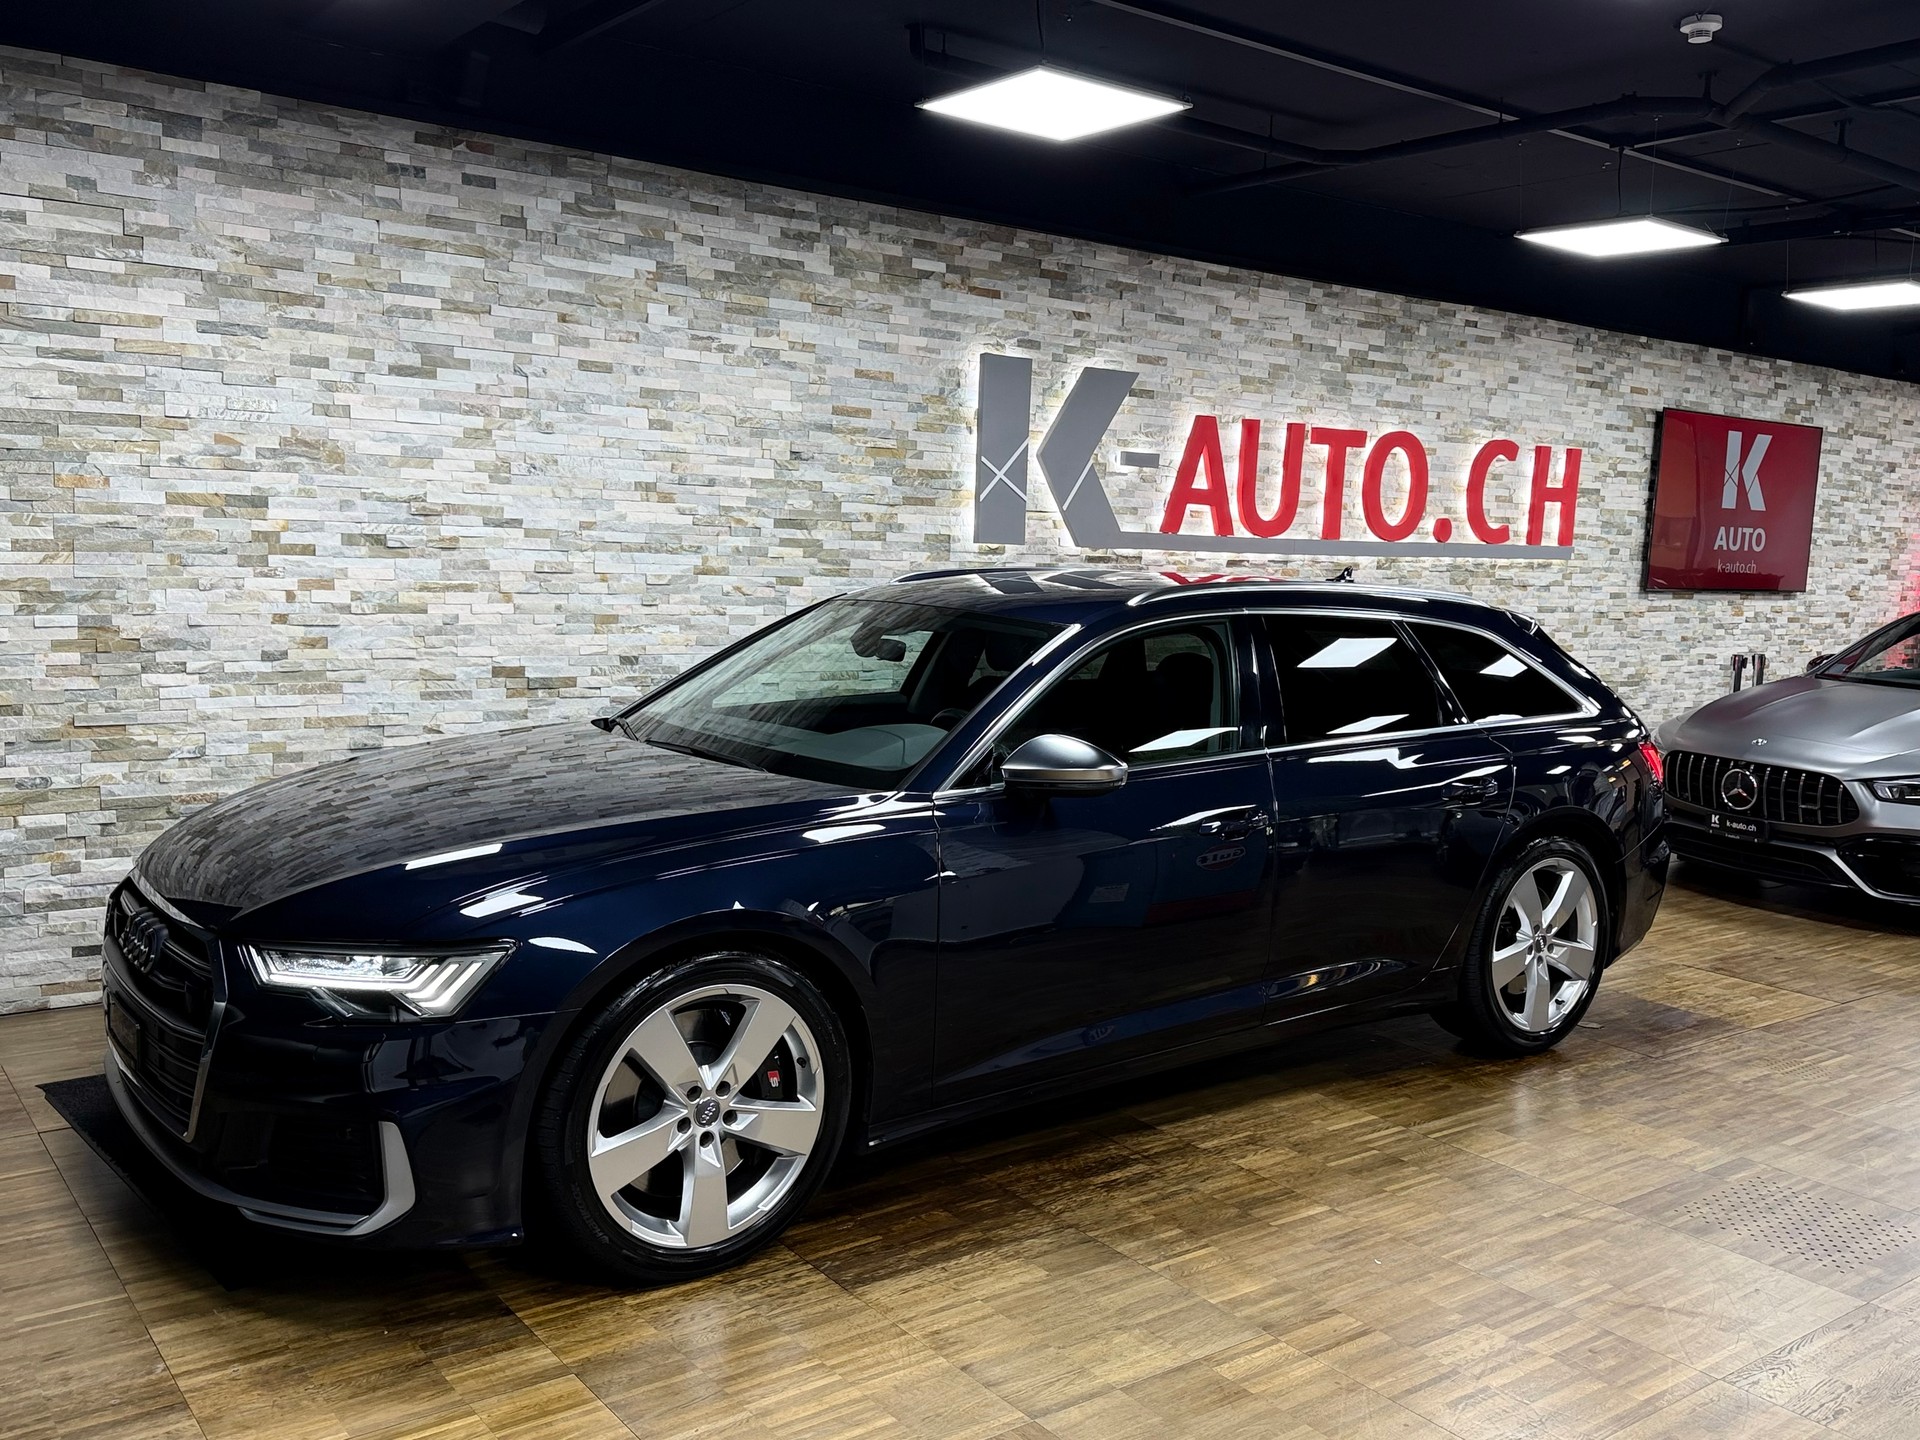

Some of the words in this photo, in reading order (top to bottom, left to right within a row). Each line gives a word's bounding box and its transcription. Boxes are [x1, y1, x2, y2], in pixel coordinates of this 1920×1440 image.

[974, 353, 1581, 549] K-AUTO.CH
[1721, 430, 1773, 511] K
[1713, 526, 1766, 552] AUTO
[1717, 559, 1757, 574] k-auto.ch
[1726, 819, 1757, 832] k-auto.ch
